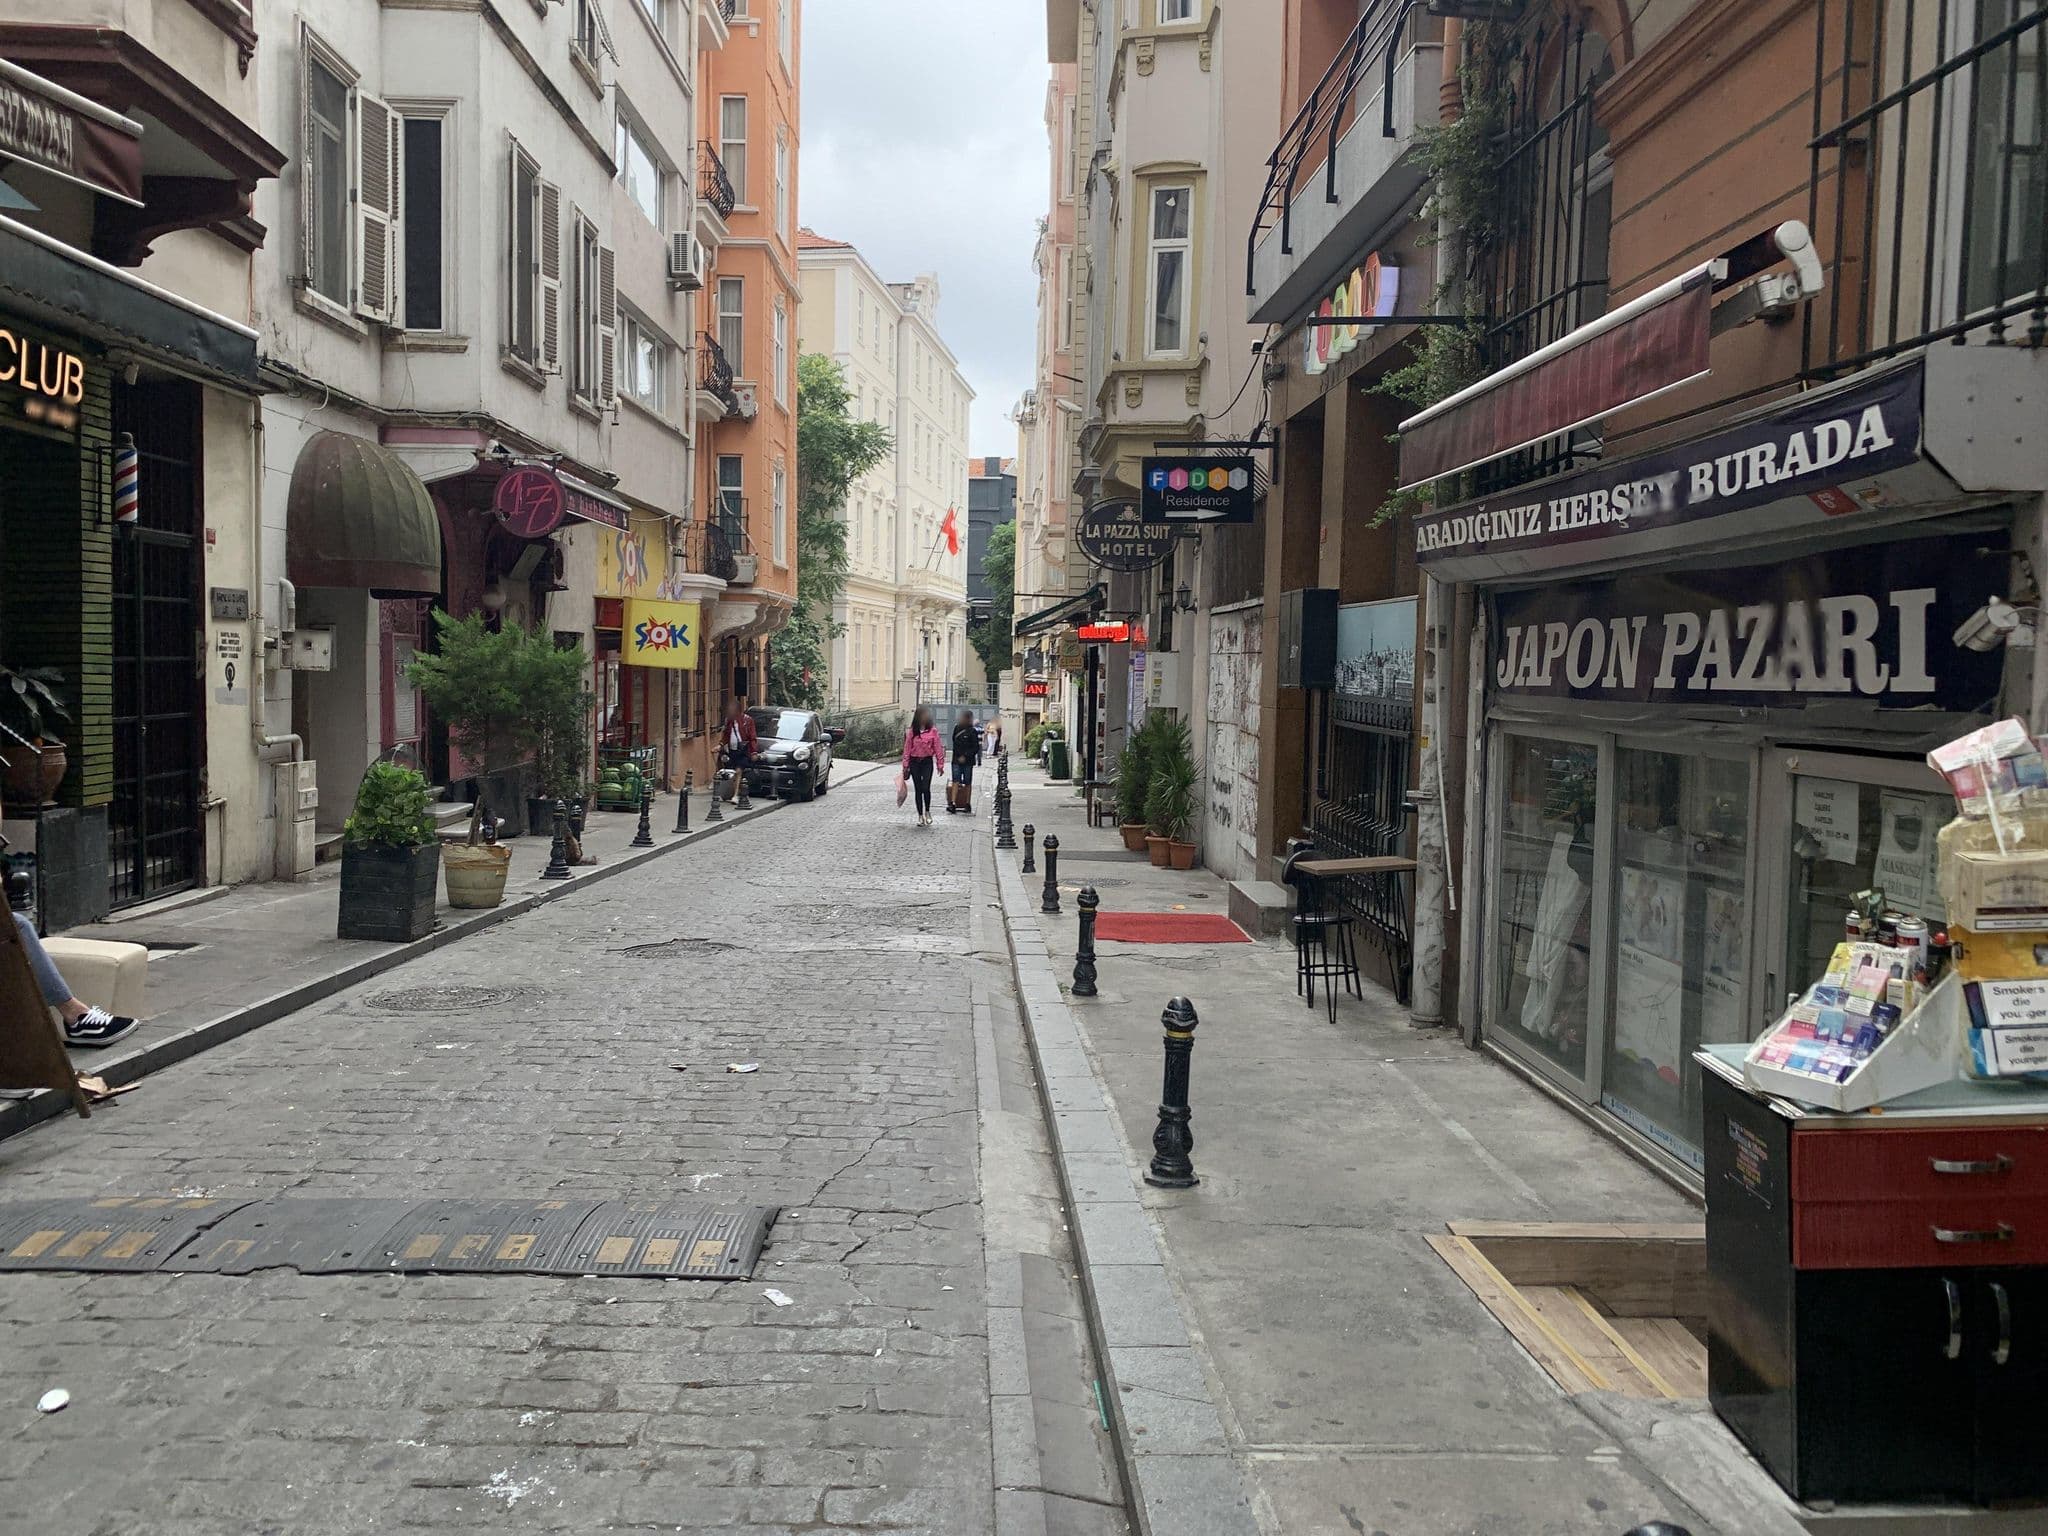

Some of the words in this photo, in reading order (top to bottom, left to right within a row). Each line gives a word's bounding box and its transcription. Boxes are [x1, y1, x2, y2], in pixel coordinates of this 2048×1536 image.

[1415, 504, 1542, 553] ARADIĞINIZ
[1688, 404, 1895, 505] BURADA
[510, 472, 554, 534] 17
[1166, 494, 1231, 507] Residence
[1086, 524, 1102, 539] LA
[1104, 524, 1141, 540] PAZZA
[1100, 543, 1156, 557] HOTEL
[634, 620, 691, 652] ŞOK
[1496, 616, 1648, 690] JAPON
[1653, 587, 1937, 695] PAZARI
[1992, 984, 2046, 996] Smokers
[2012, 998, 2031, 1007] die
[2000, 1009, 2047, 1020] youger
